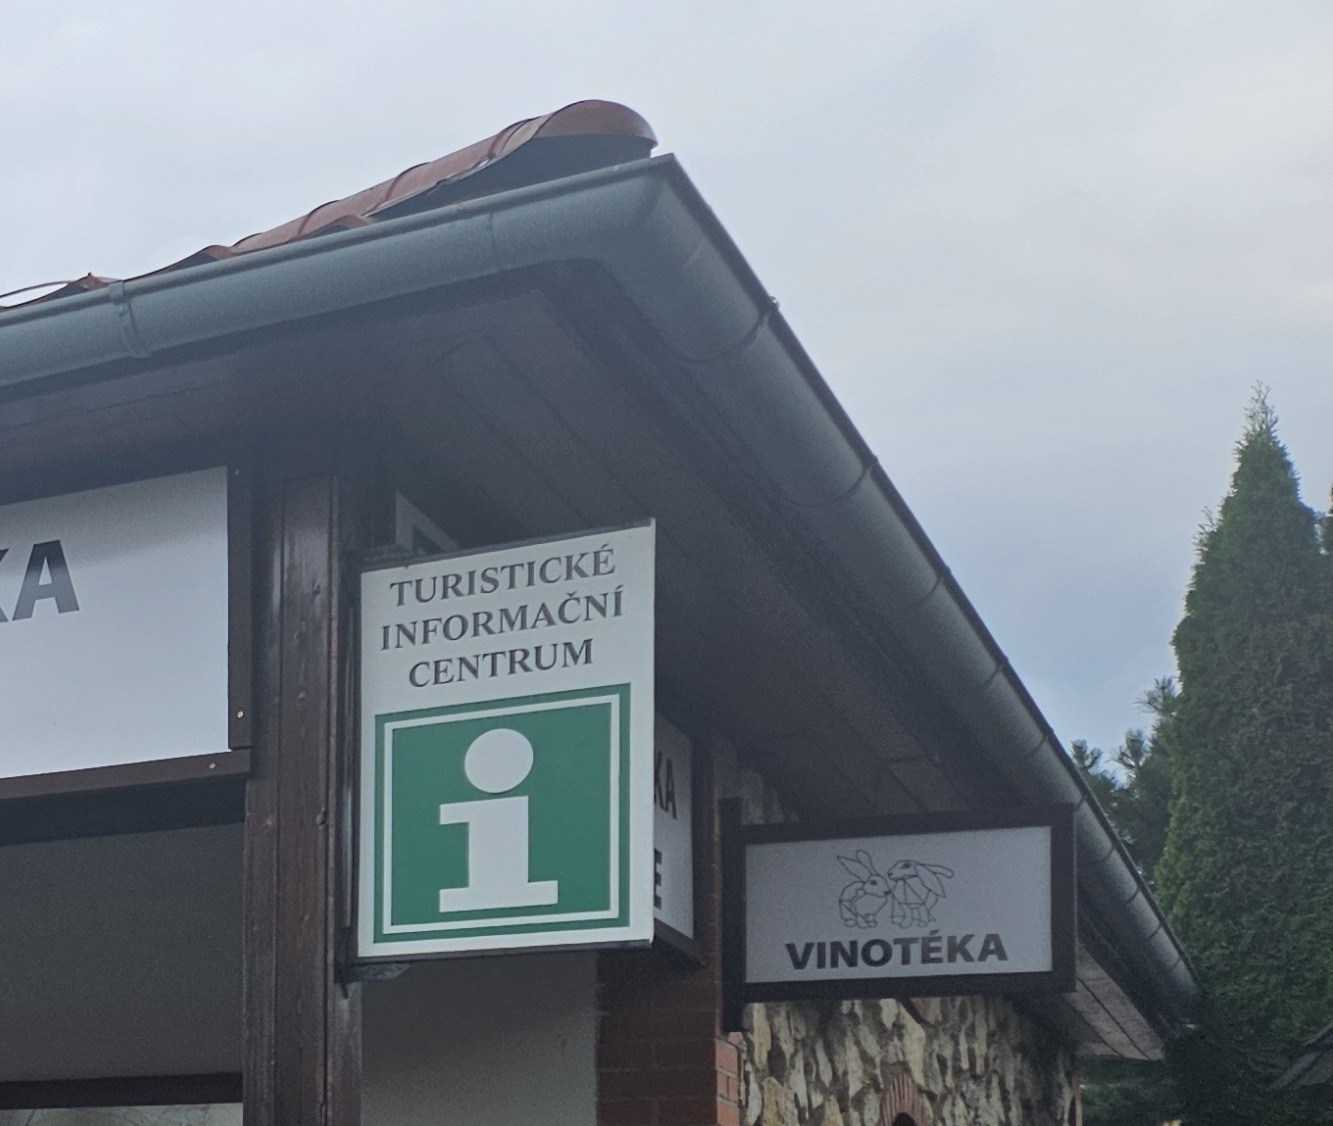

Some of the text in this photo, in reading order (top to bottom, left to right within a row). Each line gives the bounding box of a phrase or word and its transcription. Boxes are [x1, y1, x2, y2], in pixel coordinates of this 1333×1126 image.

[389, 543, 615, 607] TURISTICKÉ
[381, 584, 624, 651] INFORMAČNÍ
[408, 638, 593, 688] CENTRUM
[784, 929, 1009, 971] VINOTÉKA
